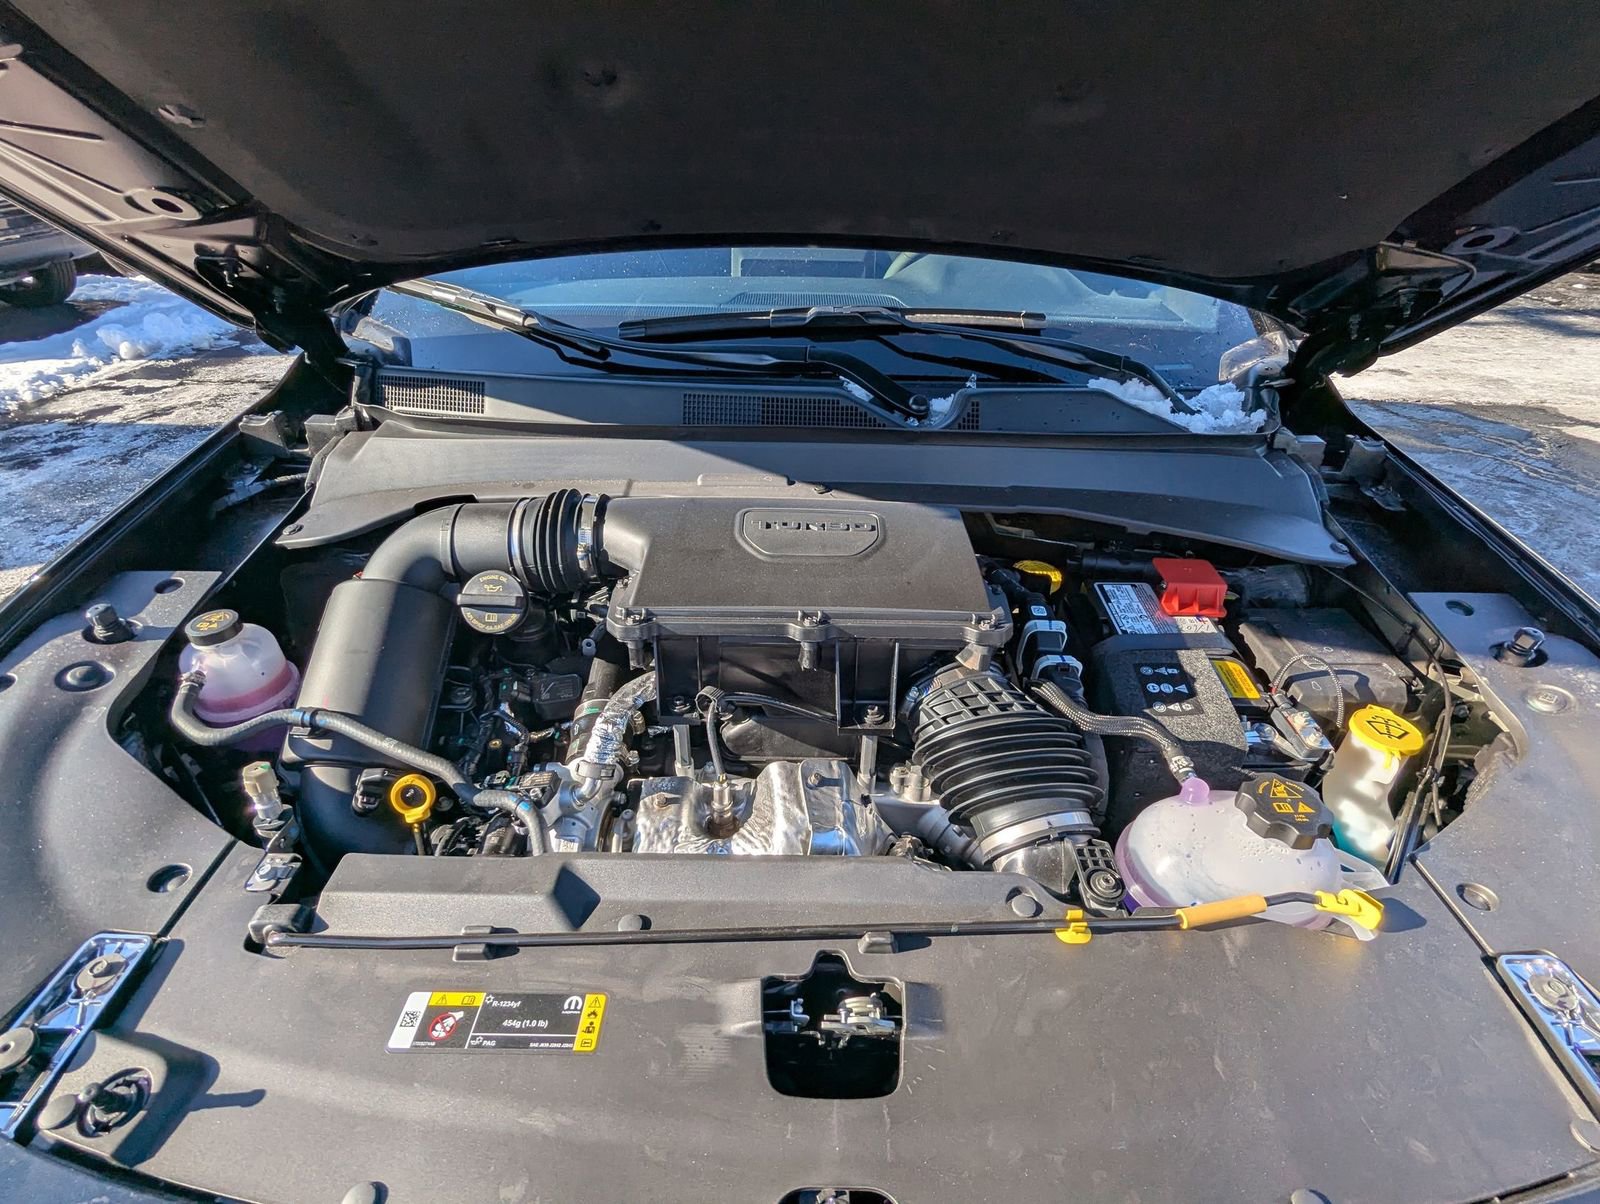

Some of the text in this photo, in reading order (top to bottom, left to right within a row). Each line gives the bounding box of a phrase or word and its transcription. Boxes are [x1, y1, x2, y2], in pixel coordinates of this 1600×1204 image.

[492, 1000, 521, 1009] R-1234yf
[502, 1019, 549, 1029] 454g (1.0 lb)
